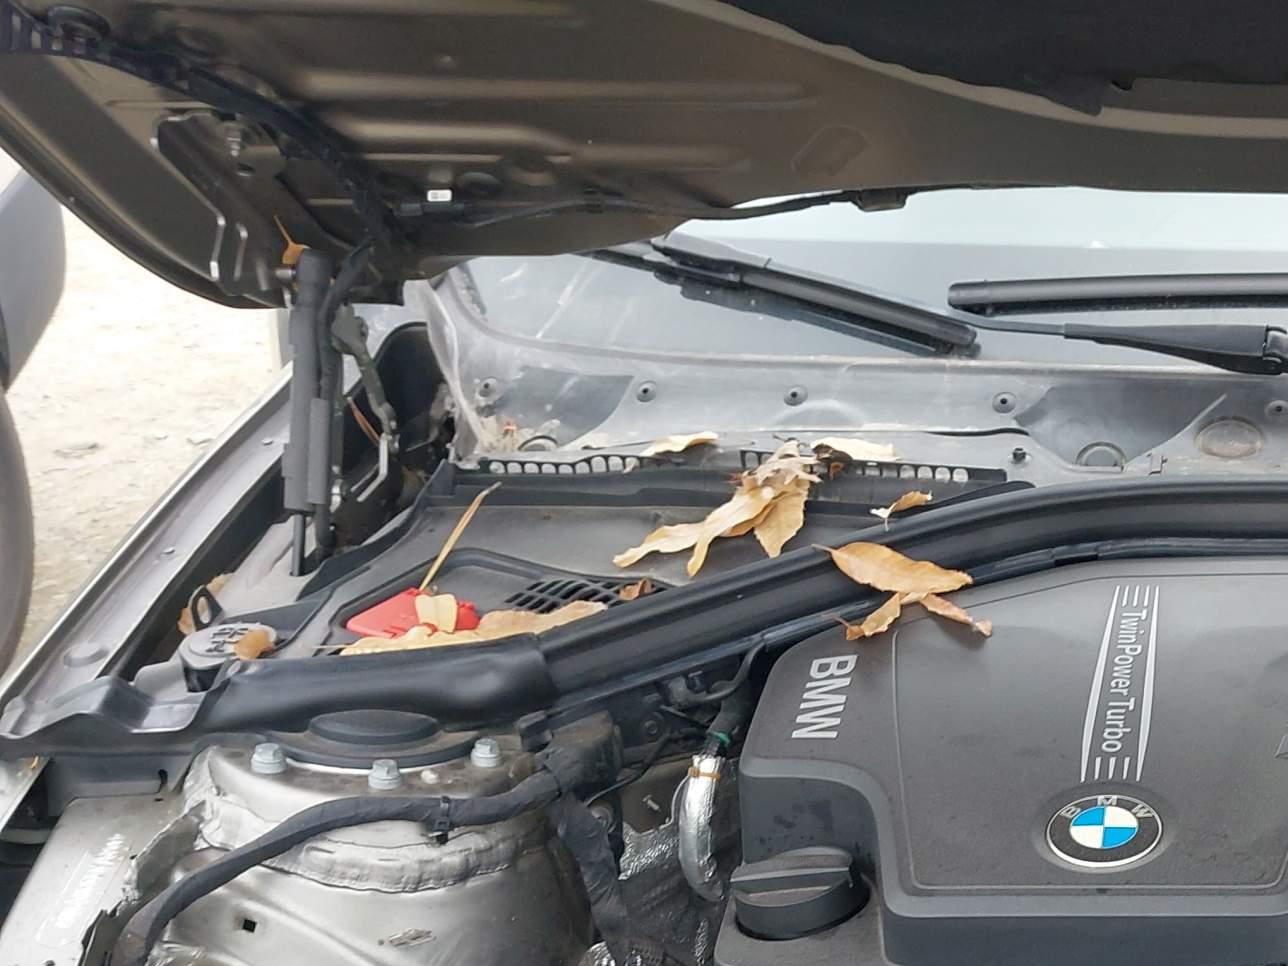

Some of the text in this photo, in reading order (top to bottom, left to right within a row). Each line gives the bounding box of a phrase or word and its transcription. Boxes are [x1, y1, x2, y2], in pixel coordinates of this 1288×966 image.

[791, 654, 858, 738] BMW
[1101, 608, 1147, 753] TwinPower Turbo
[1060, 795, 1154, 819] BMW
